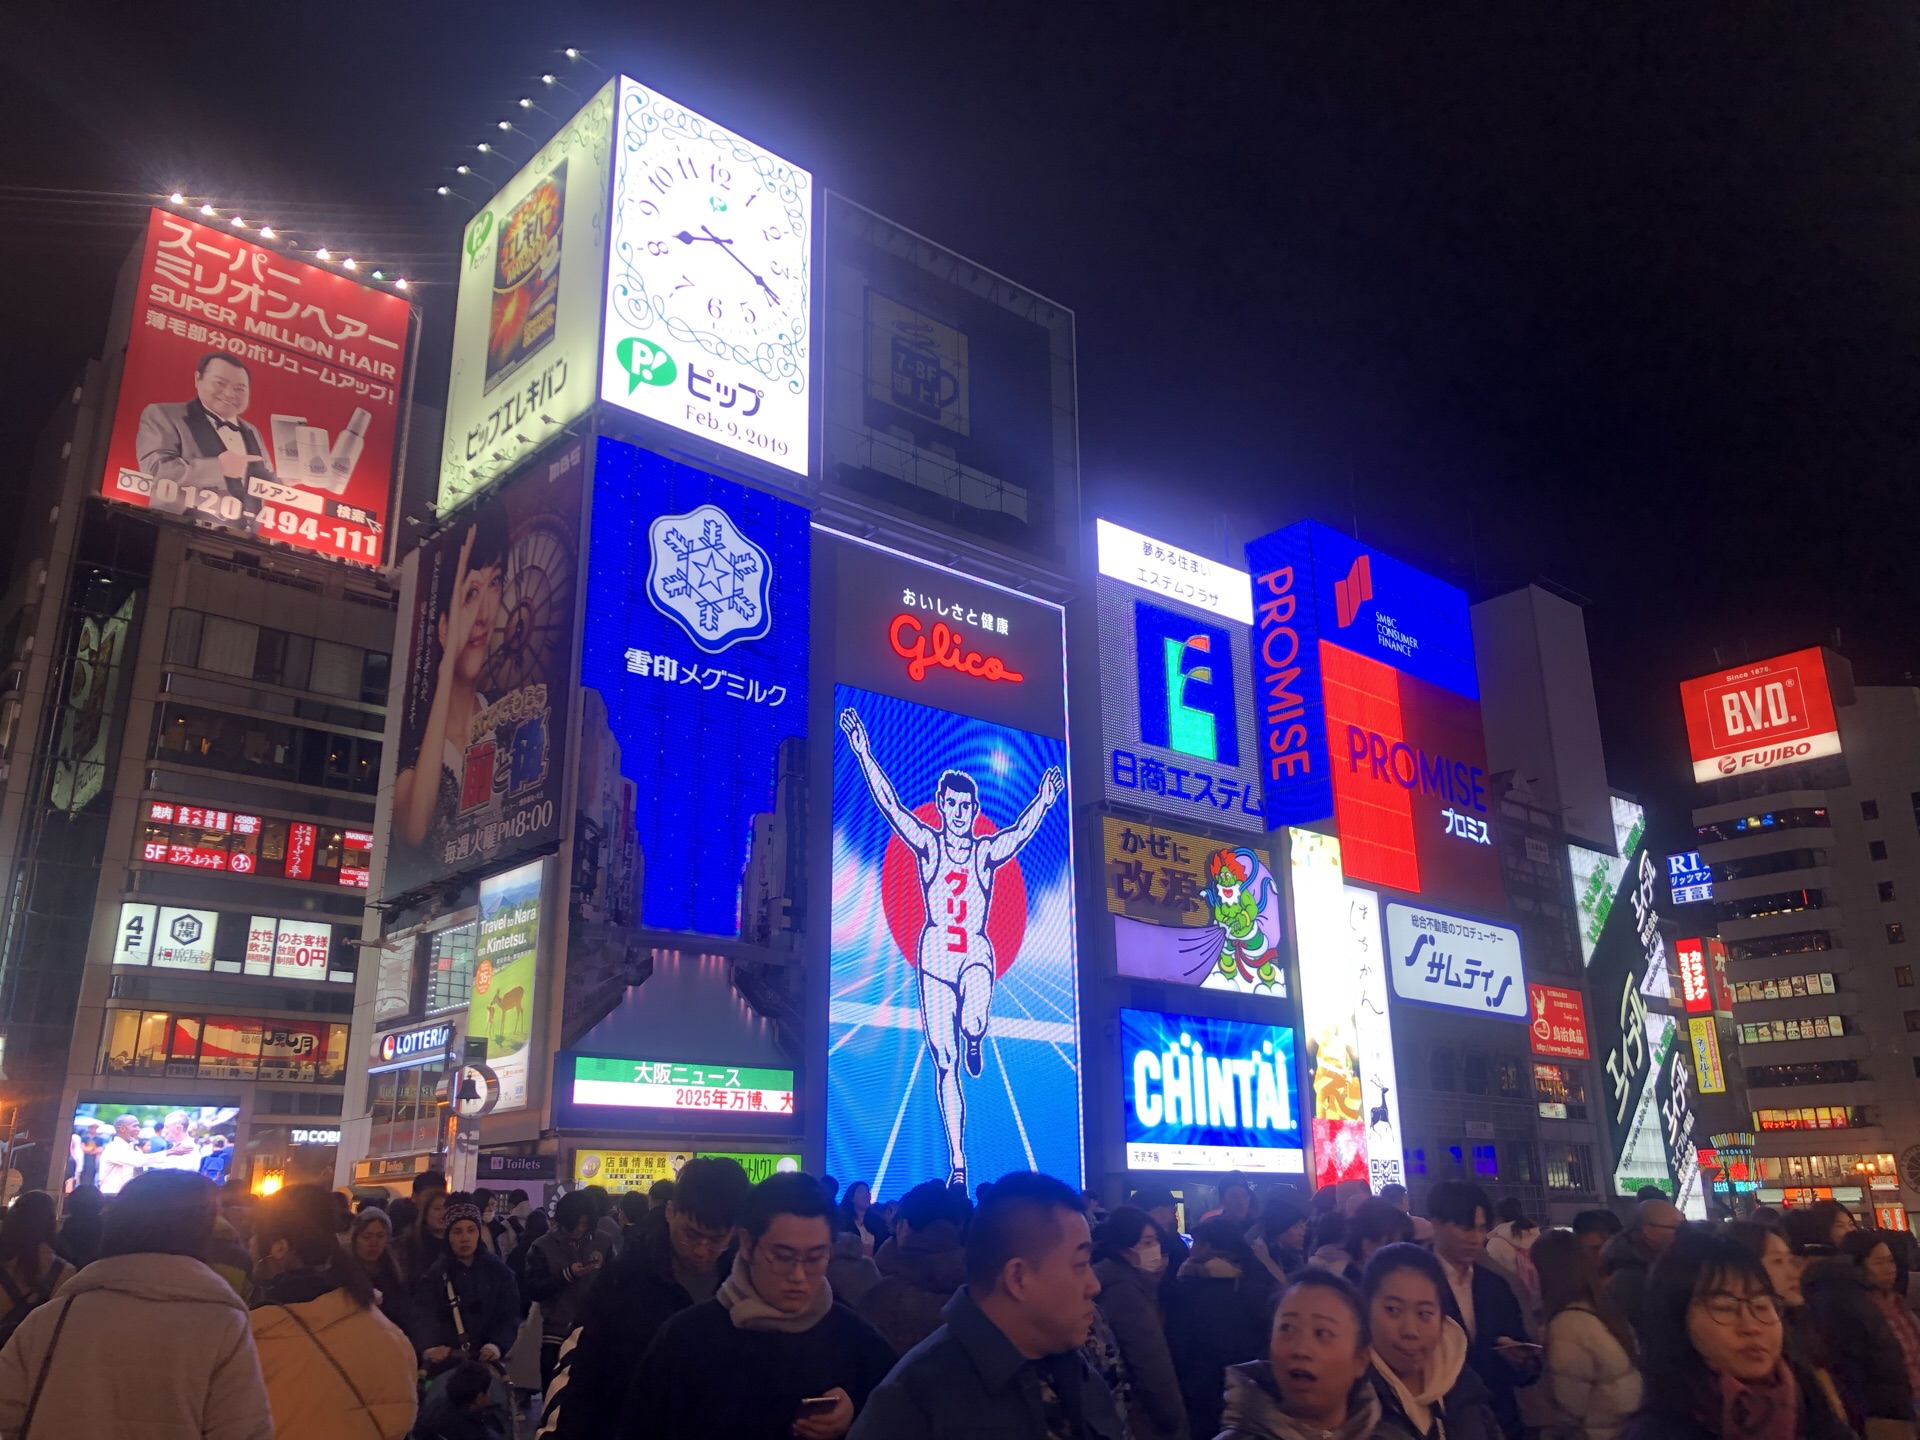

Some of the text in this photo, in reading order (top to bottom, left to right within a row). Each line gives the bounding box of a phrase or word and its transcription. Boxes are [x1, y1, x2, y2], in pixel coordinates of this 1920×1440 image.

[648, 165, 674, 195] 10
[677, 157, 699, 180] 11
[710, 163, 731, 190] 12
[639, 200, 661, 219] 9
[745, 194, 757, 208] 1
[647, 241, 669, 256] 8
[762, 226, 781, 242] 2
[158, 219, 301, 286] スーパー
[674, 274, 695, 290] 7
[769, 260, 790, 280] 3
[153, 250, 399, 350] ミリオンヘアー
[707, 297, 723, 319] 6
[739, 301, 756, 324] 5
[149, 283, 397, 384] SUPER MILLION HAIR
[688, 362, 765, 418] ピップ
[466, 359, 568, 462] ピップエレキバン
[686, 404, 724, 432] Feb.
[746, 427, 788, 456] 2019
[252, 482, 299, 502] ルアン
[156, 478, 378, 557] 0120-494-111
[336, 503, 368, 524] 検索
[1142, 541, 1212, 577] 夢ある住まい
[902, 588, 1009, 636] おいしさと健康
[1375, 611, 1398, 630] SMBC
[889, 613, 1024, 682] Glico
[1376, 623, 1419, 650] CONSUMER
[1378, 634, 1412, 658] FINANCE
[624, 647, 787, 707] 雪印メグミルク
[1257, 566, 1311, 780] PROMISE
[1726, 672, 1748, 682] Since
[1722, 682, 1797, 737] B.V.D.
[1347, 723, 1487, 813] PROMISE
[1741, 742, 1811, 768] FUJIBO
[1113, 749, 1265, 818] 日商エステム
[152, 805, 173, 820] 焼肉
[1441, 807, 1491, 845] プロミス
[145, 844, 167, 860] 5F
[1118, 827, 1190, 864] かぜに
[1630, 857, 1656, 920] エイブル
[480, 914, 507, 935] Travel
[514, 907, 537, 925] Nara
[944, 867, 968, 953] グリコ
[124, 915, 144, 952] 4F
[250, 929, 328, 948] 女性のお客様
[486, 932, 527, 954] Kintetsu.
[1411, 913, 1504, 943] 総合不動産のプロデューサー
[1424, 951, 1494, 992] サムティ
[1690, 950, 1708, 1000] カラオケ
[396, 1028, 450, 1055] LOTTERIA
[1606, 986, 1647, 1100] エイブル
[634, 1062, 741, 1088] 大阪ニュース
[1695, 1037, 1713, 1088] ネットルーム
[1133, 1032, 1291, 1130] CHINTAI
[1663, 1059, 1689, 1131] エイブル
[506, 1158, 541, 1170] Toilets
[605, 1156, 667, 1168] 店舗情報館
